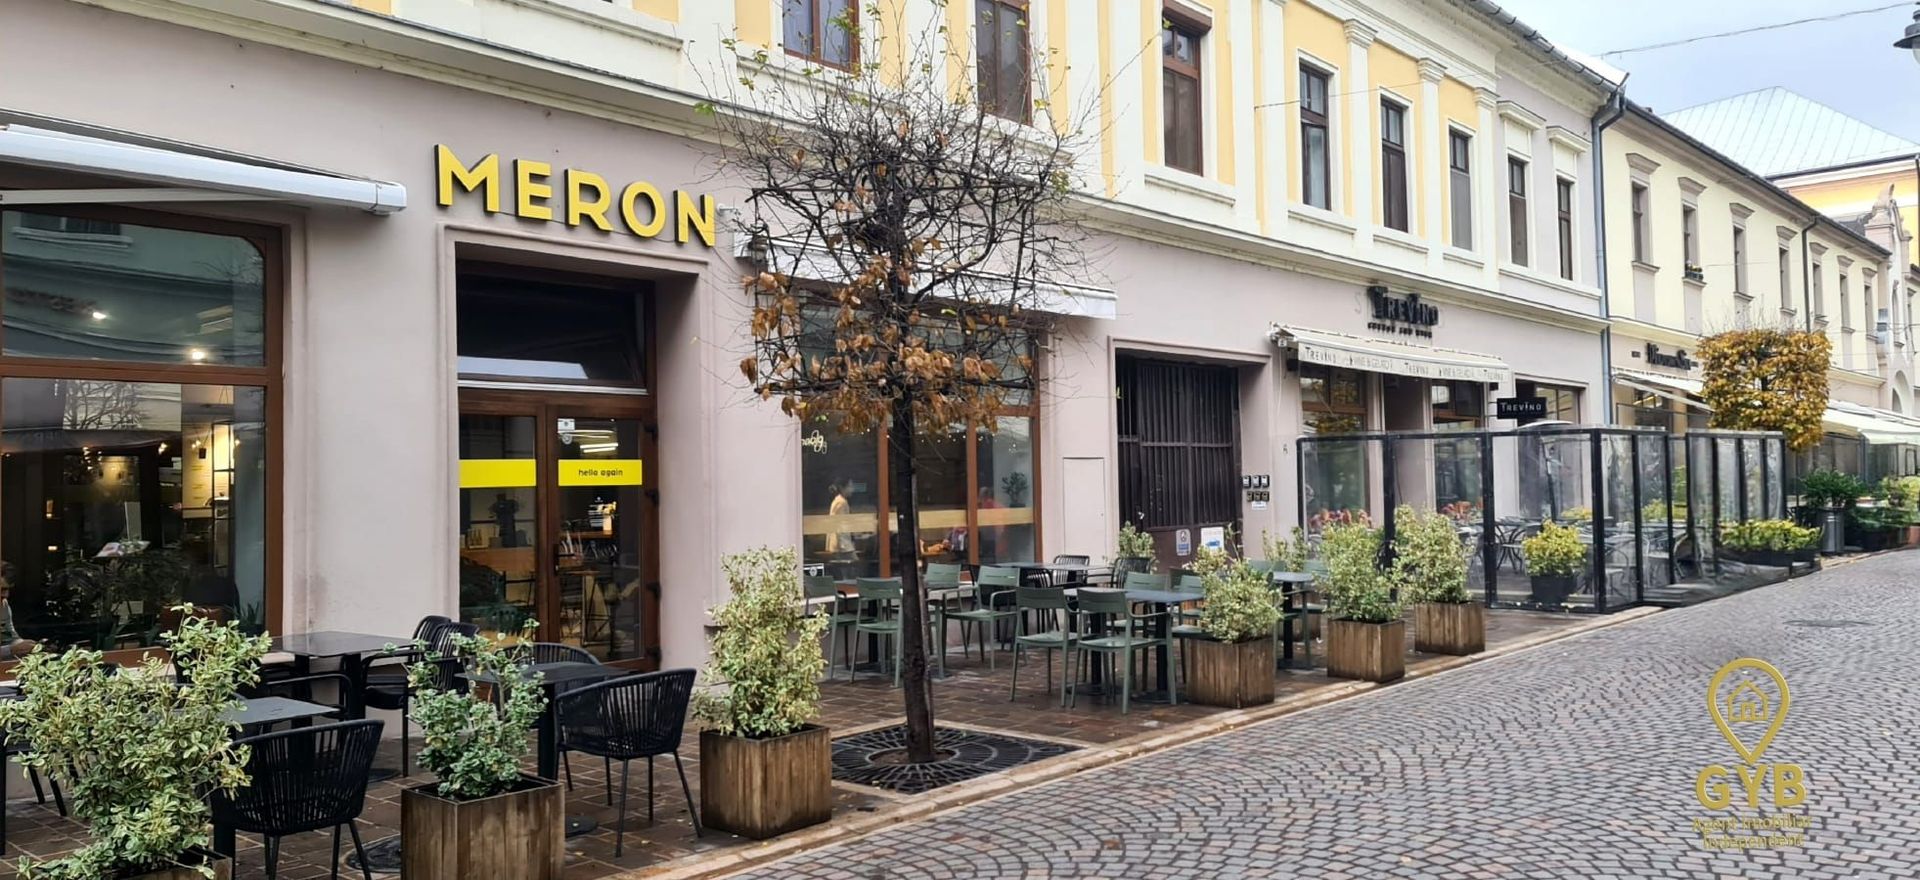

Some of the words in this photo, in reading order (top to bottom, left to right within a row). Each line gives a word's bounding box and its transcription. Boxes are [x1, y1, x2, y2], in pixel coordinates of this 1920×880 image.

[434, 144, 715, 246] MERON
[1367, 286, 1438, 326] TREVINO
[1501, 402, 1542, 412] TREVINO
[578, 469, 598, 477] hello
[600, 469, 623, 477] again
